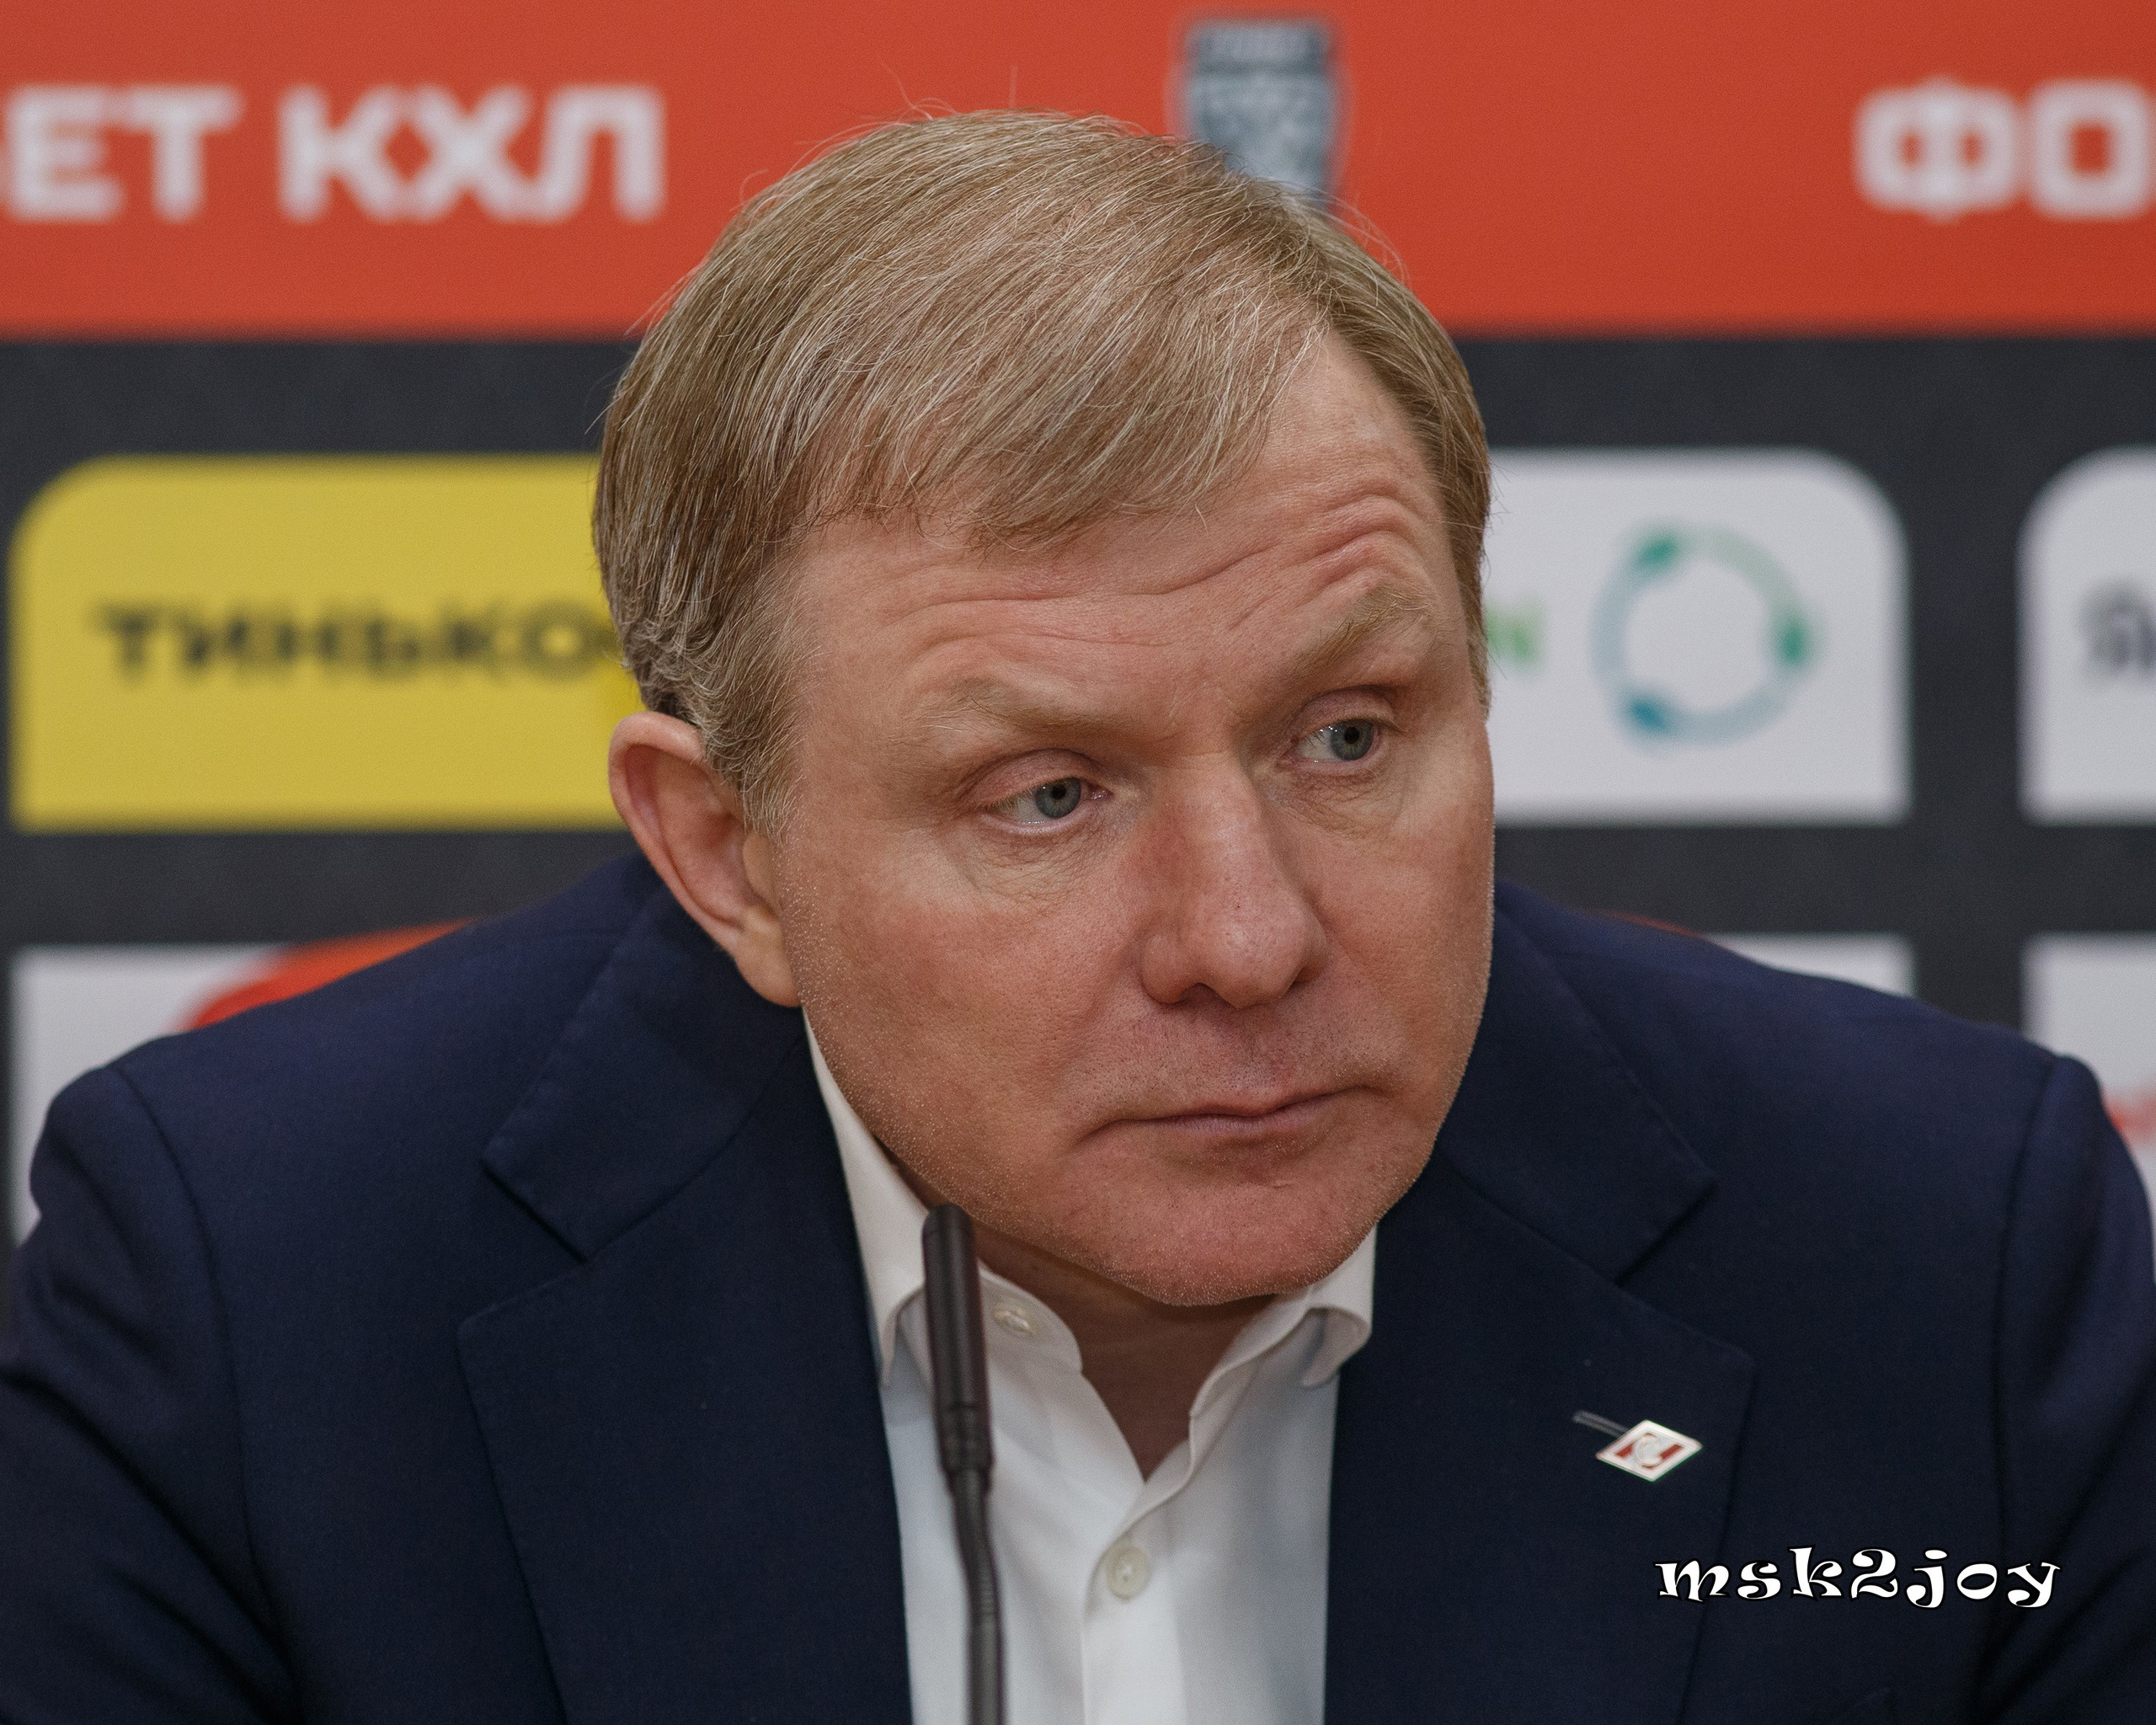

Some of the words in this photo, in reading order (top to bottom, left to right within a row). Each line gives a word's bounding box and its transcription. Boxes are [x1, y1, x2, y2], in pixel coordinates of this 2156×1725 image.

[0, 85, 238, 221] ЕТ
[277, 85, 666, 221] КХЛ
[93, 601, 613, 679] ТИНЬКО
